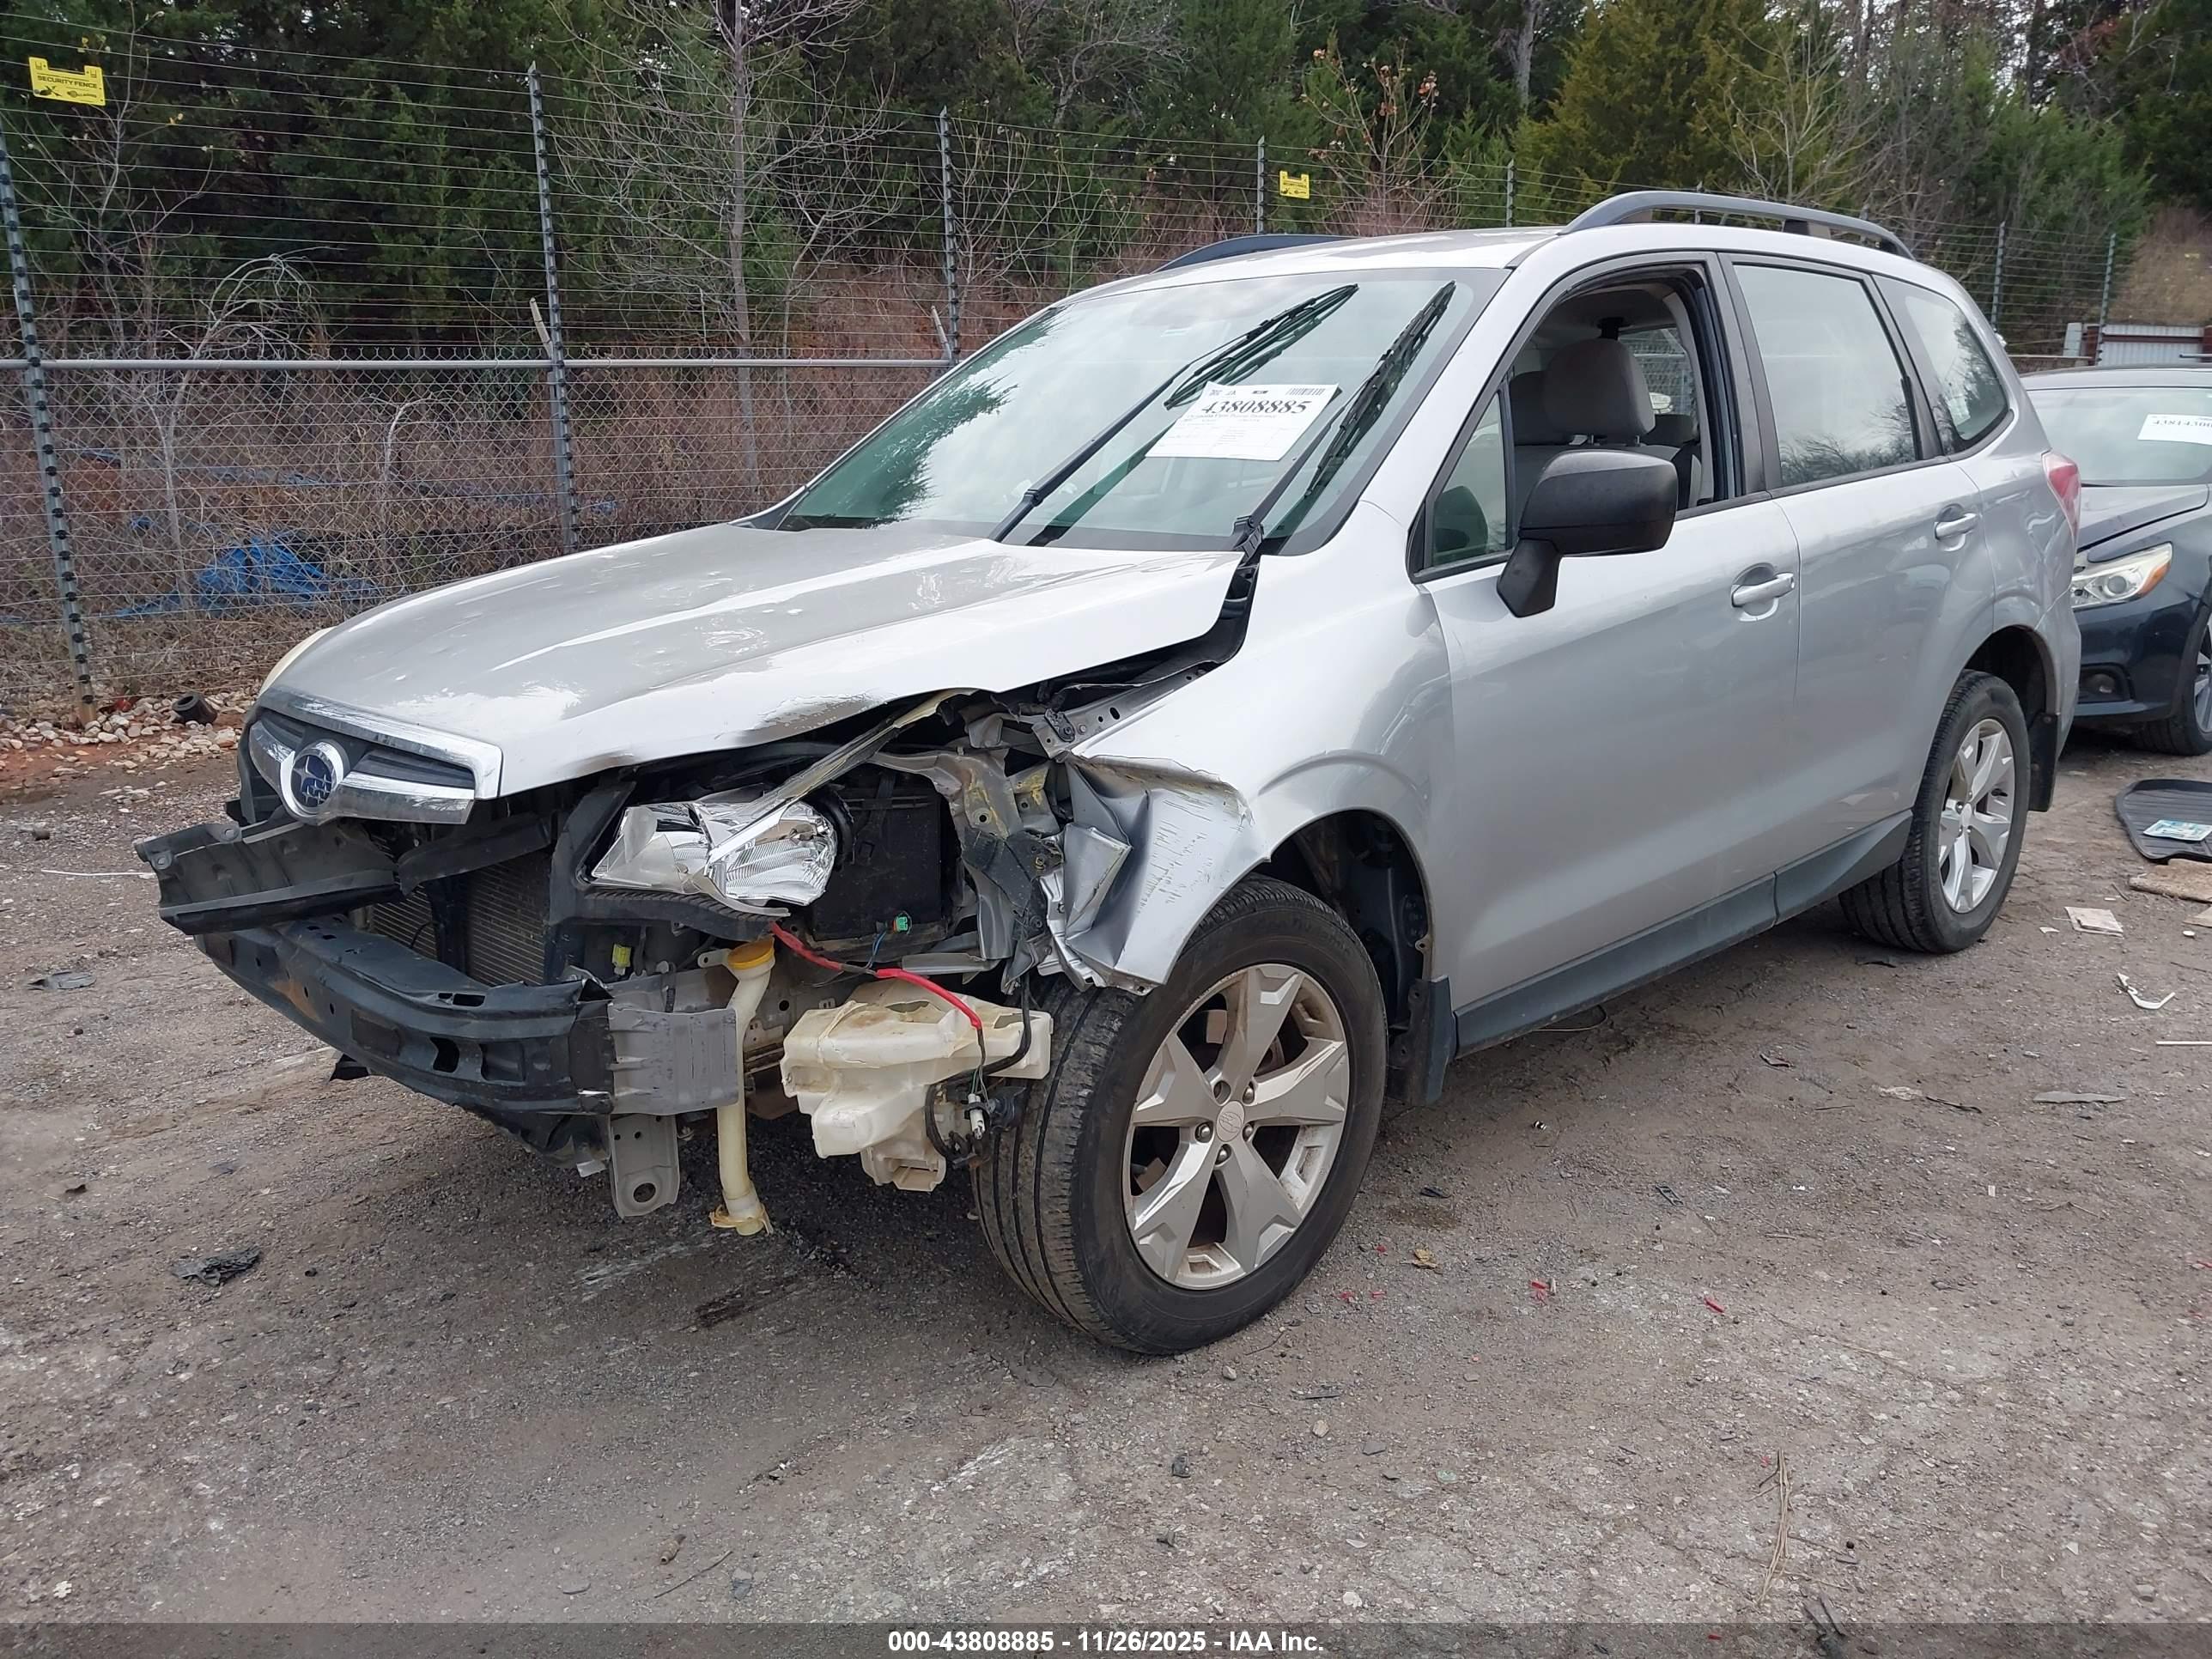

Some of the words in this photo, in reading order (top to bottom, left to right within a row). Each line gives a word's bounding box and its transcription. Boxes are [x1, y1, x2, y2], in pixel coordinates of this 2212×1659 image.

[37, 75, 74, 86] SECURITY
[74, 81, 98, 89] FENCE
[1201, 399, 1313, 414] 43808885
